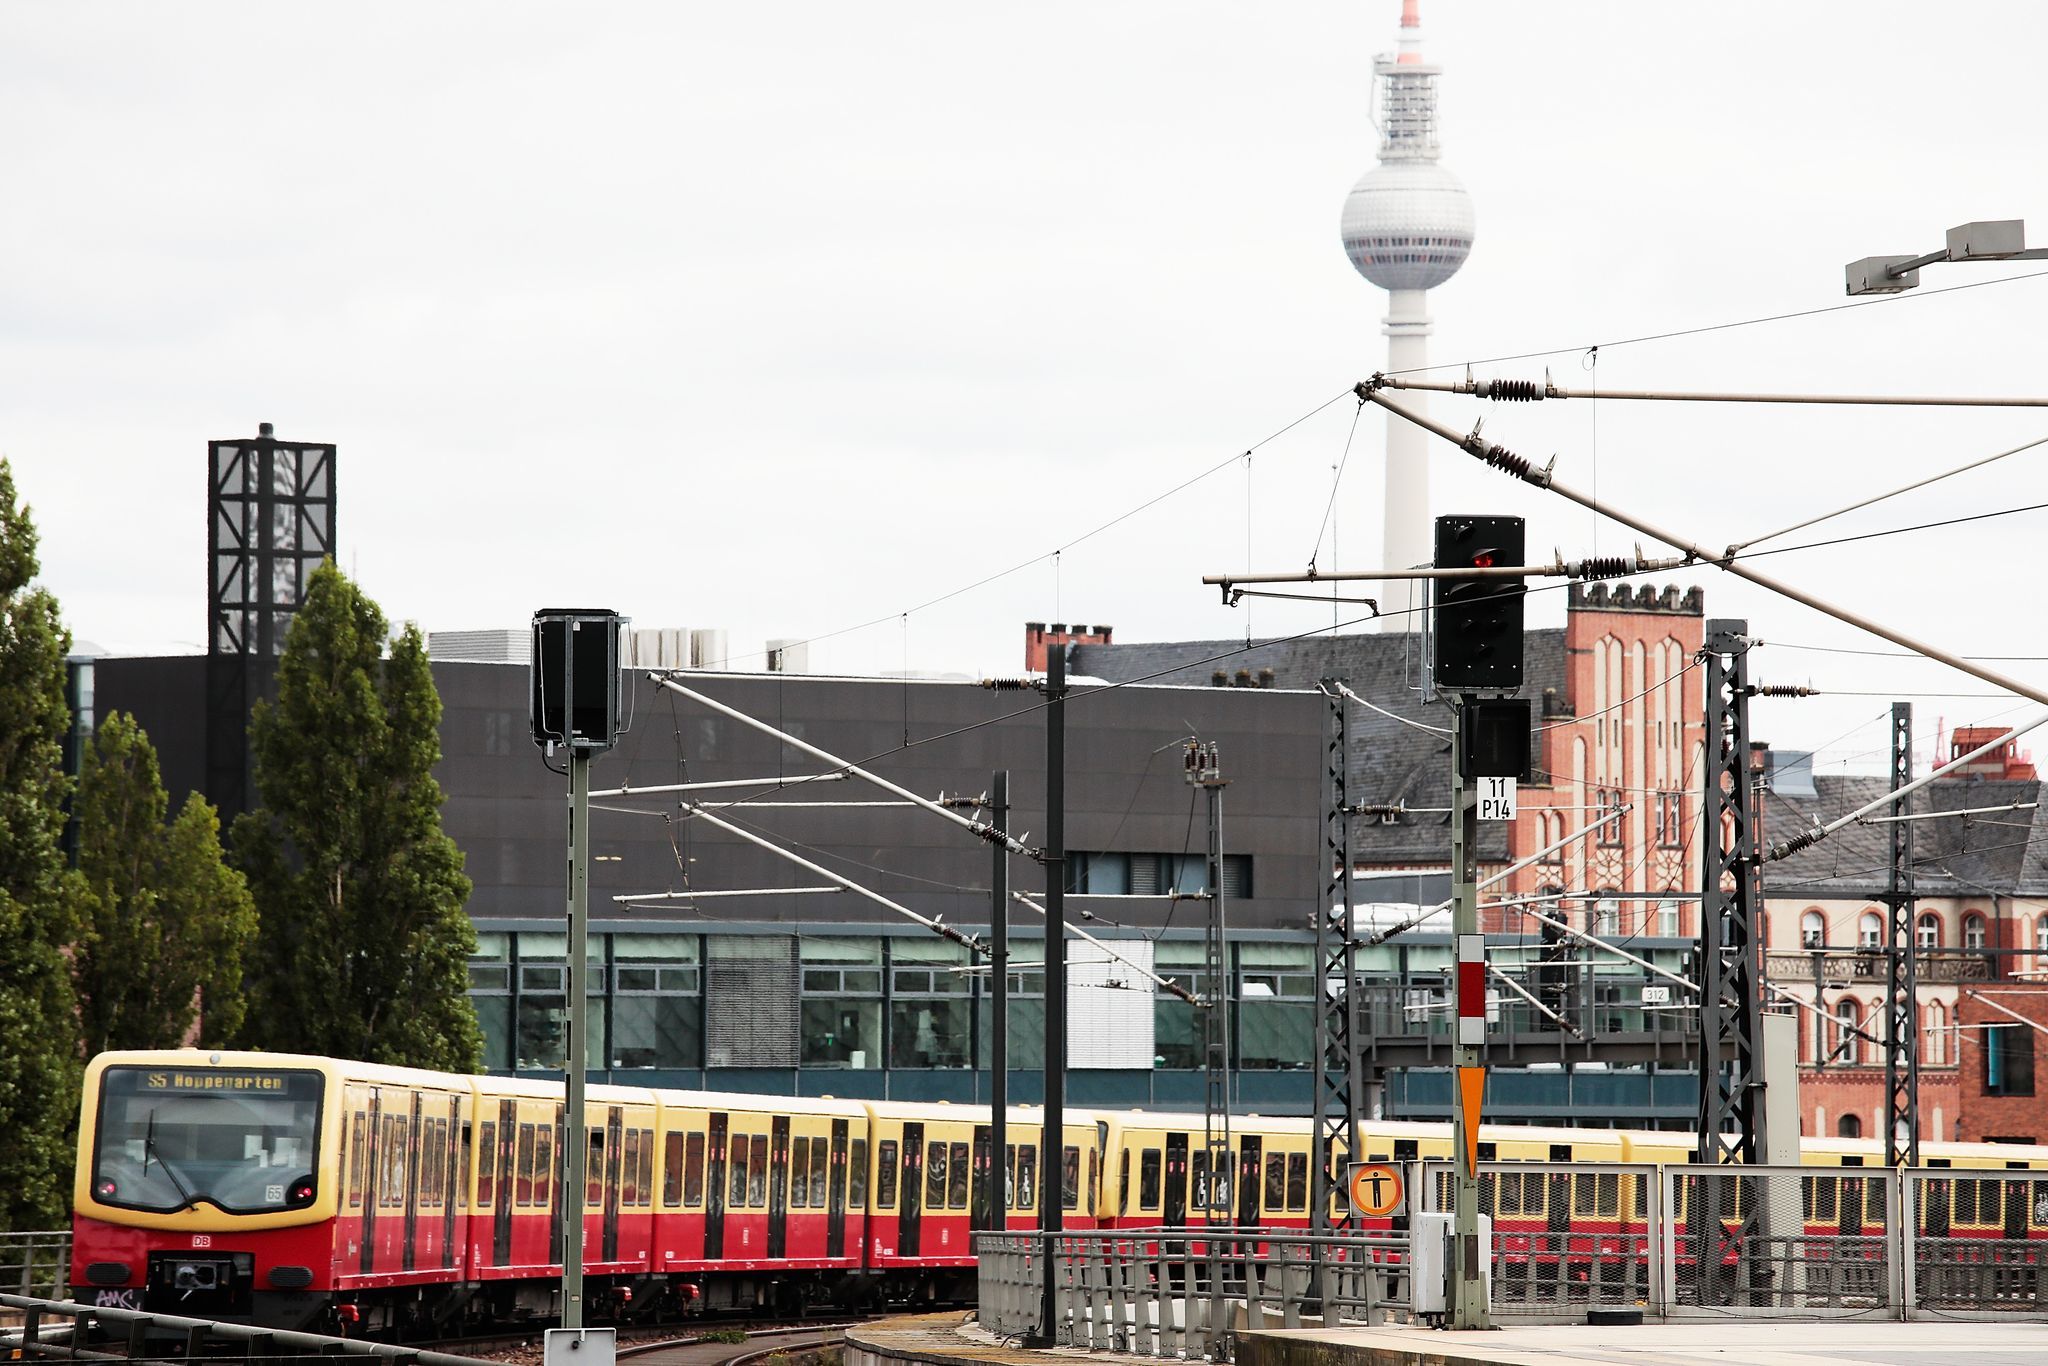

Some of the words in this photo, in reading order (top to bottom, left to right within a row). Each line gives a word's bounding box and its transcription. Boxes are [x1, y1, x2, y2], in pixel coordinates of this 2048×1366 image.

[1490, 779, 1505, 797] 11
[1483, 799, 1510, 818] P14
[1647, 990, 1664, 1000] 312
[148, 1073, 168, 1088] S5
[174, 1074, 282, 1089] Hoppegarten
[267, 1187, 281, 1200] 65
[194, 1236, 209, 1246] DB
